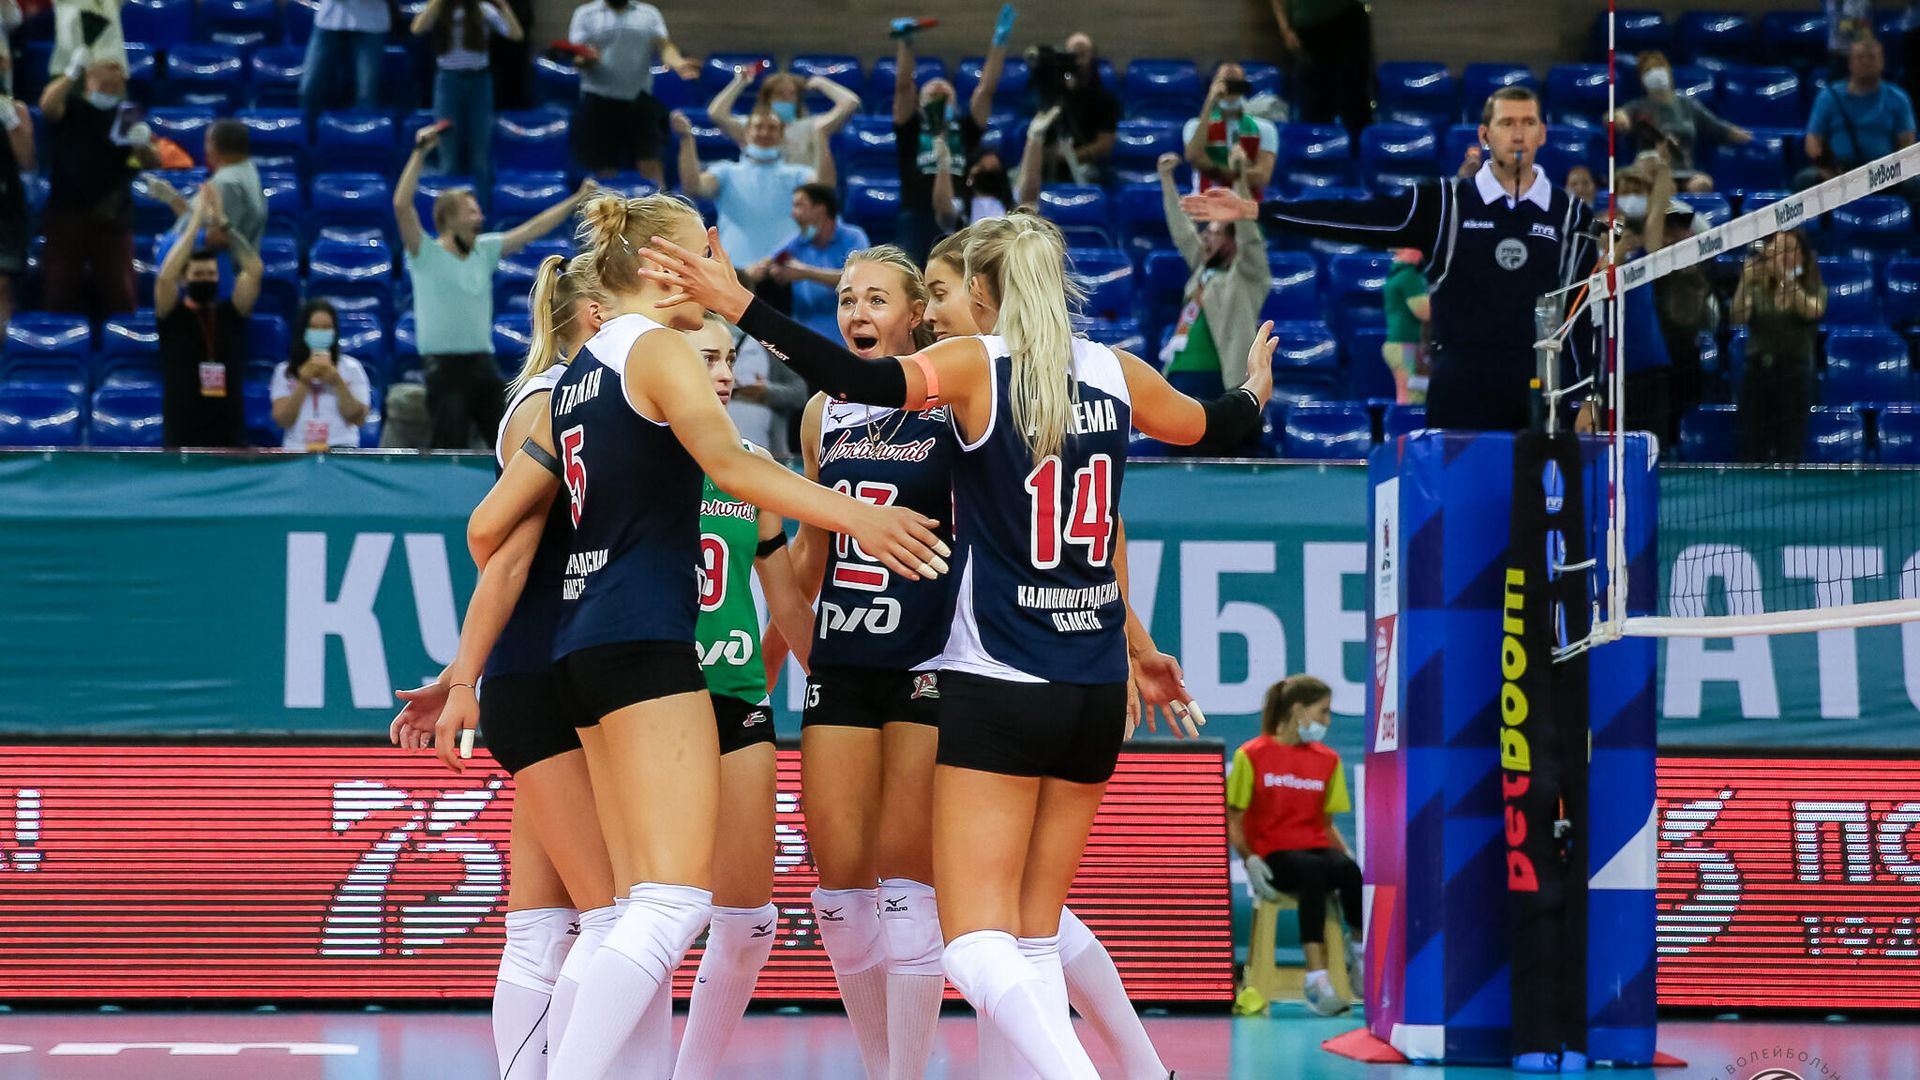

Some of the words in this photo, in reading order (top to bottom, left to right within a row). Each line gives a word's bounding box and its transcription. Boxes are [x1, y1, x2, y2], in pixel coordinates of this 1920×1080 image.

[560, 424, 587, 530] 5
[1024, 453, 1113, 570] 14
[1018, 580, 1119, 610] КАЛИНИНГРАДСКАЯ
[1052, 610, 1103, 632] ОБЛАСТЬ
